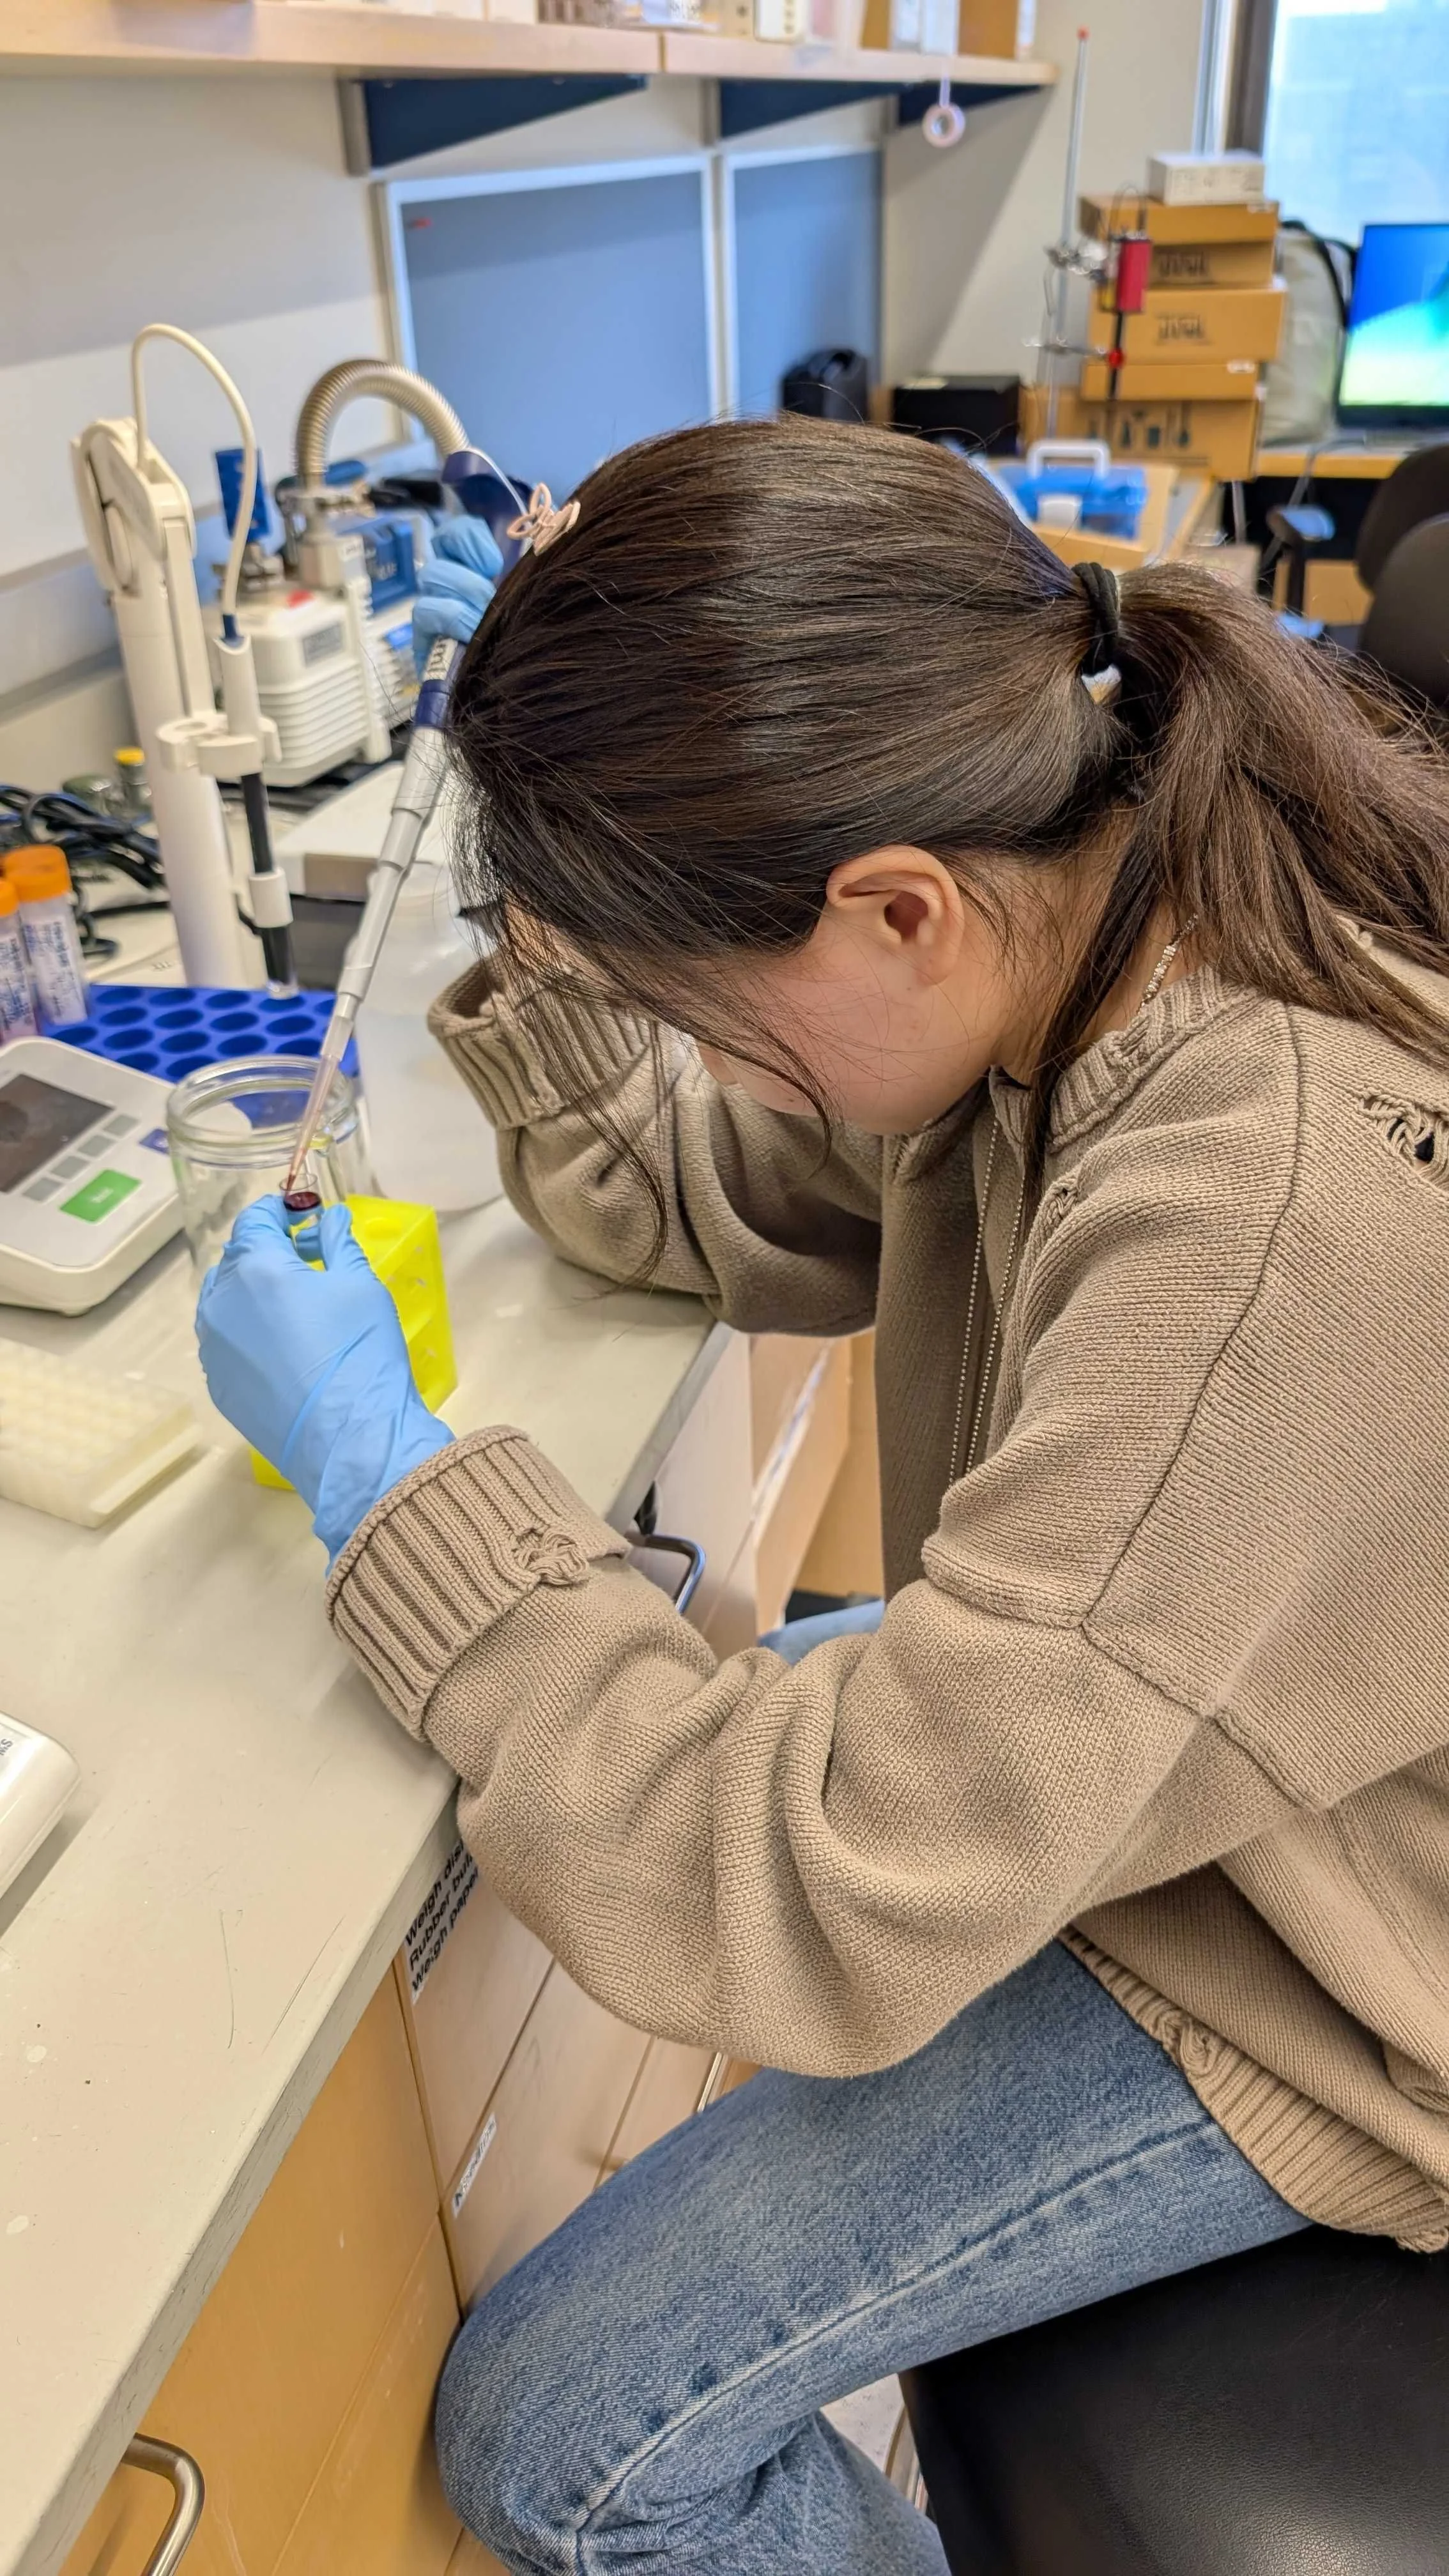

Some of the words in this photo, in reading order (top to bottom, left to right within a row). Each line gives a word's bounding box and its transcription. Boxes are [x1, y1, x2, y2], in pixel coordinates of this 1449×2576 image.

[405, 1880, 442, 1946] Weigh
[410, 1890, 450, 1971] Rubber
[411, 1926, 448, 1991] Weigh
